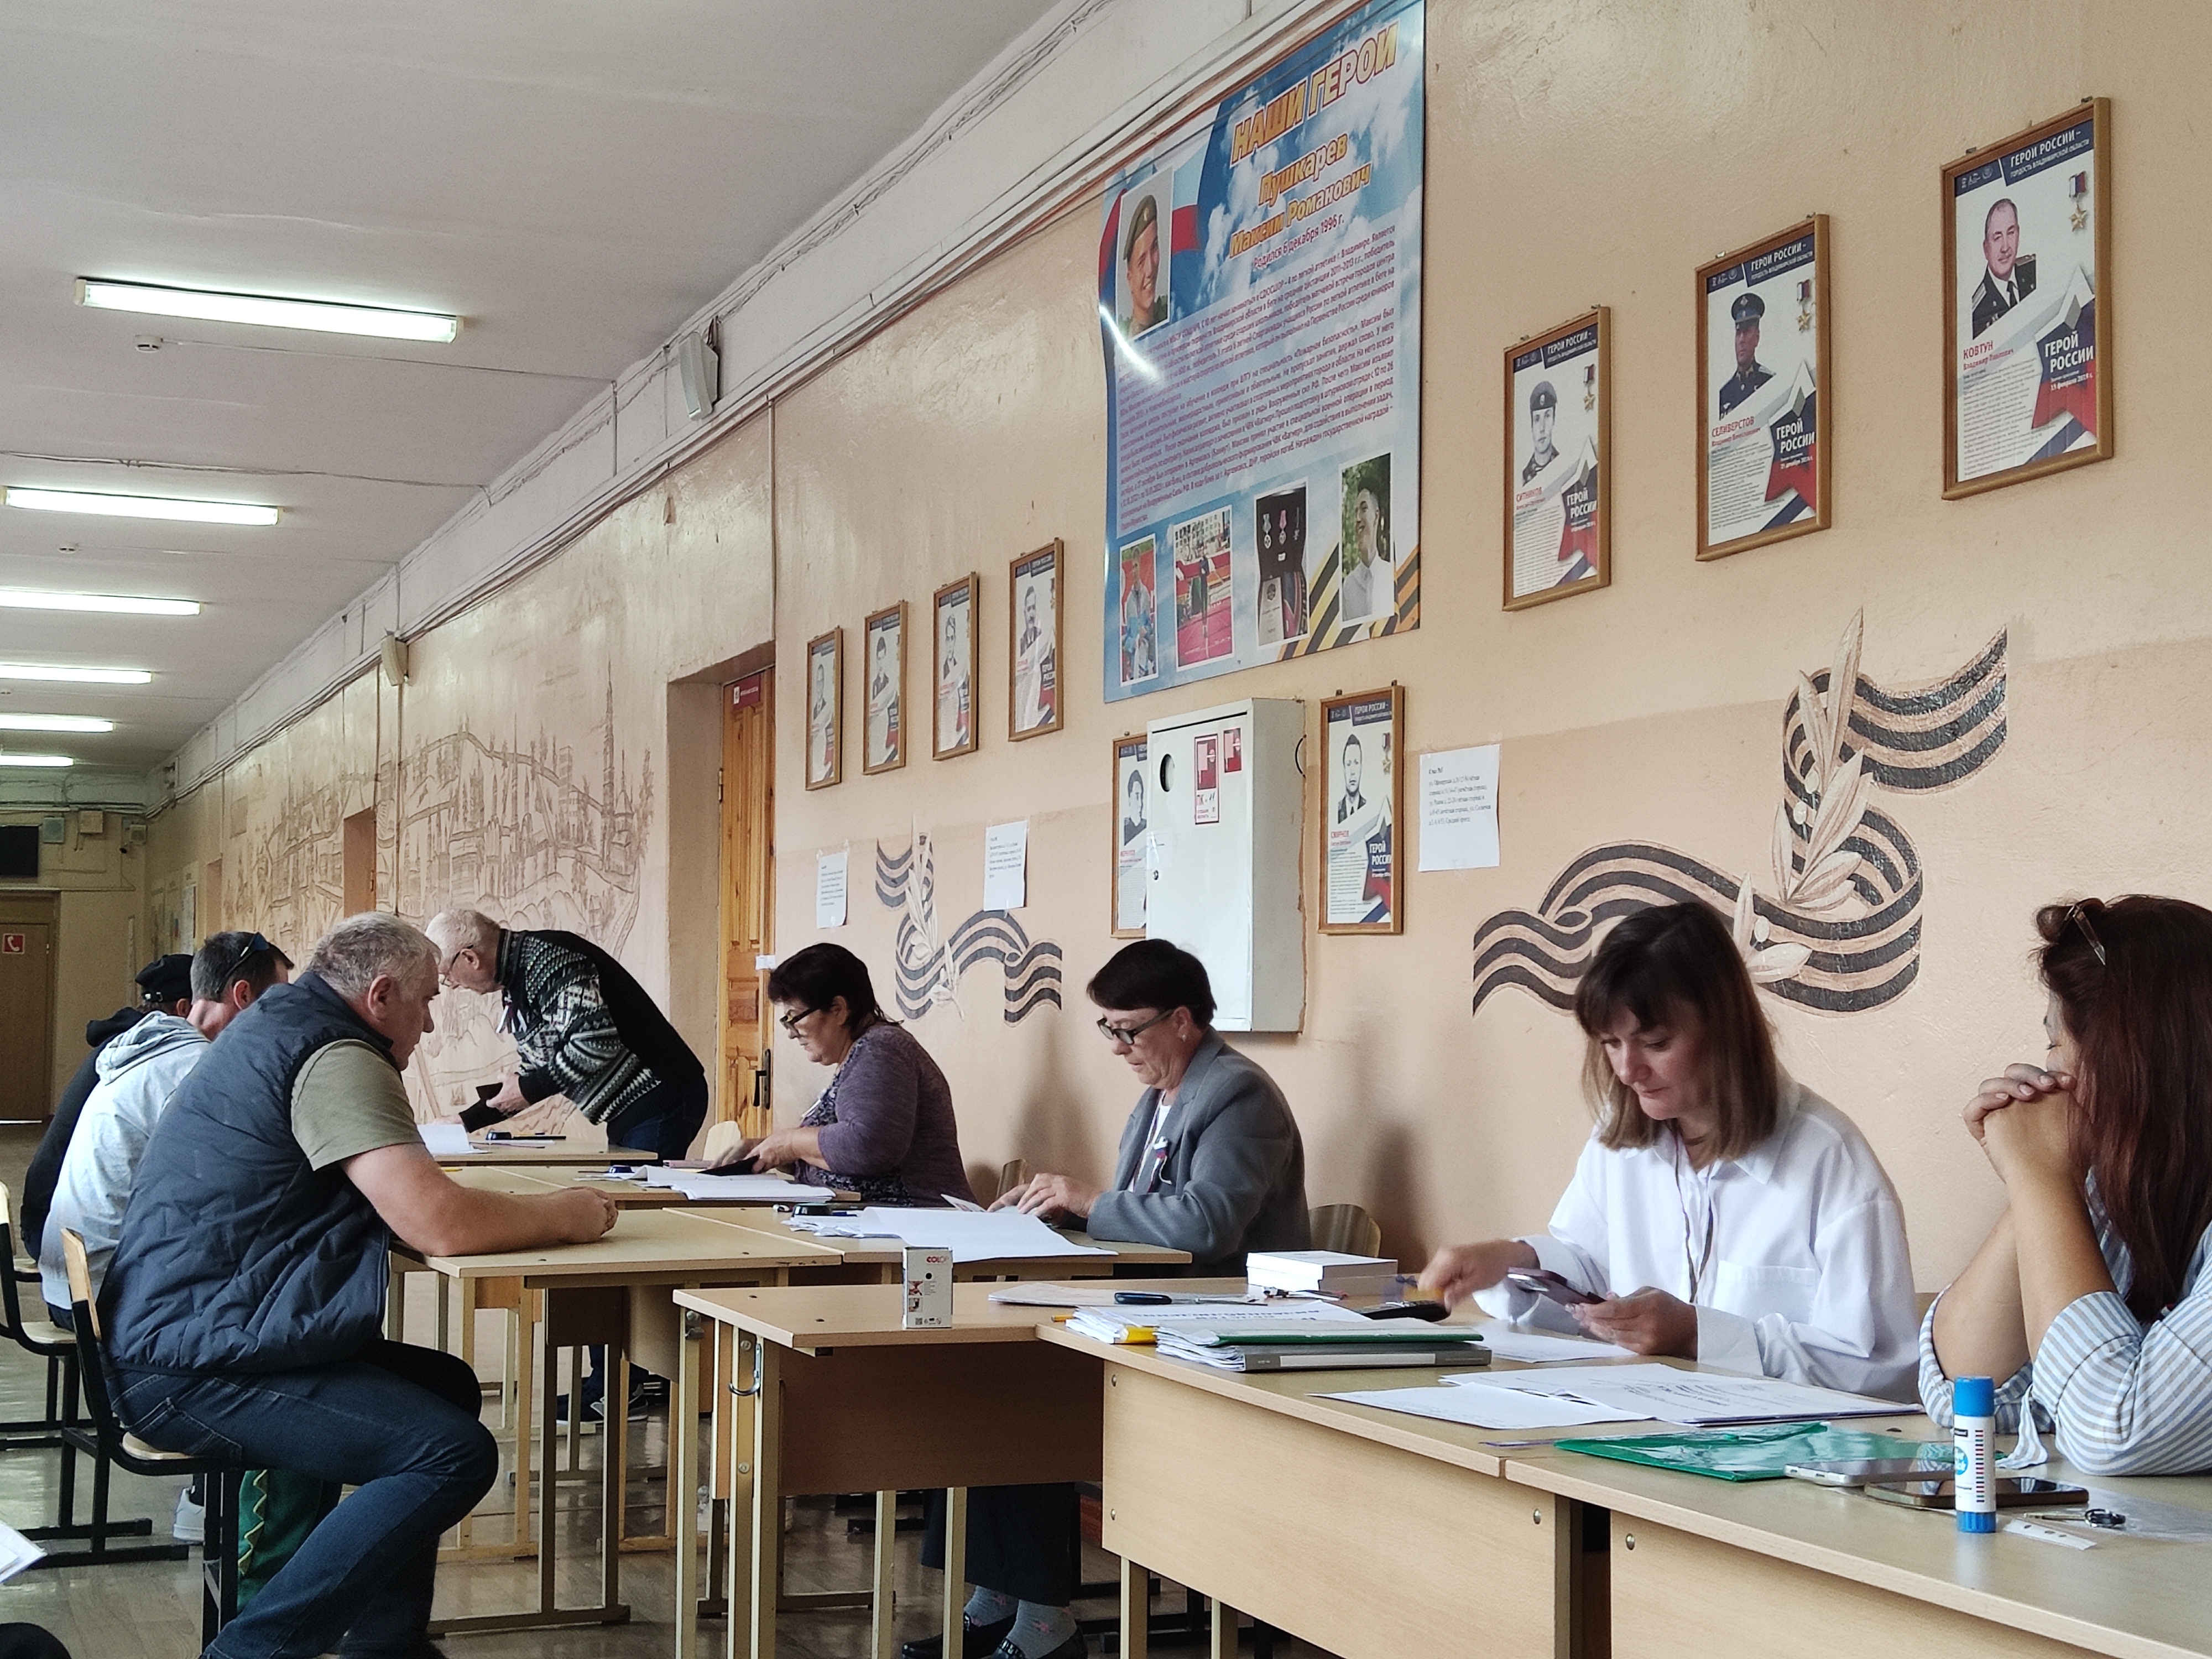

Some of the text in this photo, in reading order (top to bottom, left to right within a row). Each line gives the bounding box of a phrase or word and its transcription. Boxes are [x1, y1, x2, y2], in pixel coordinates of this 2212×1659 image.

[1232, 23, 1398, 161] НАШИ ГЕРОИ
[2010, 148, 2037, 168] ГЕРОИ
[2040, 130, 2075, 155] РОССИИ
[1259, 134, 1348, 207] Пушкарев
[1229, 164, 1371, 258] Максим Романович
[1253, 247, 1282, 269] Родился
[1288, 227, 1319, 252] декабря
[1321, 218, 1337, 233] 1996
[1751, 255, 1772, 272] ГЕРОИ
[1773, 242, 1802, 262] РОССИИ
[1566, 331, 1588, 347] РОССИИ
[1963, 341, 1993, 359] КОВТУН
[2045, 330, 2078, 357] ГЕРОЙ
[2050, 346, 2094, 373] РОССИИ
[1776, 417, 1803, 440] ГЕРОЙ
[1780, 431, 1815, 453] РОССИИ
[1567, 487, 1589, 506] ГЕРОЙ
[1571, 500, 1597, 519] РОССИИ
[1369, 840, 1386, 853] ГЕРОЙ
